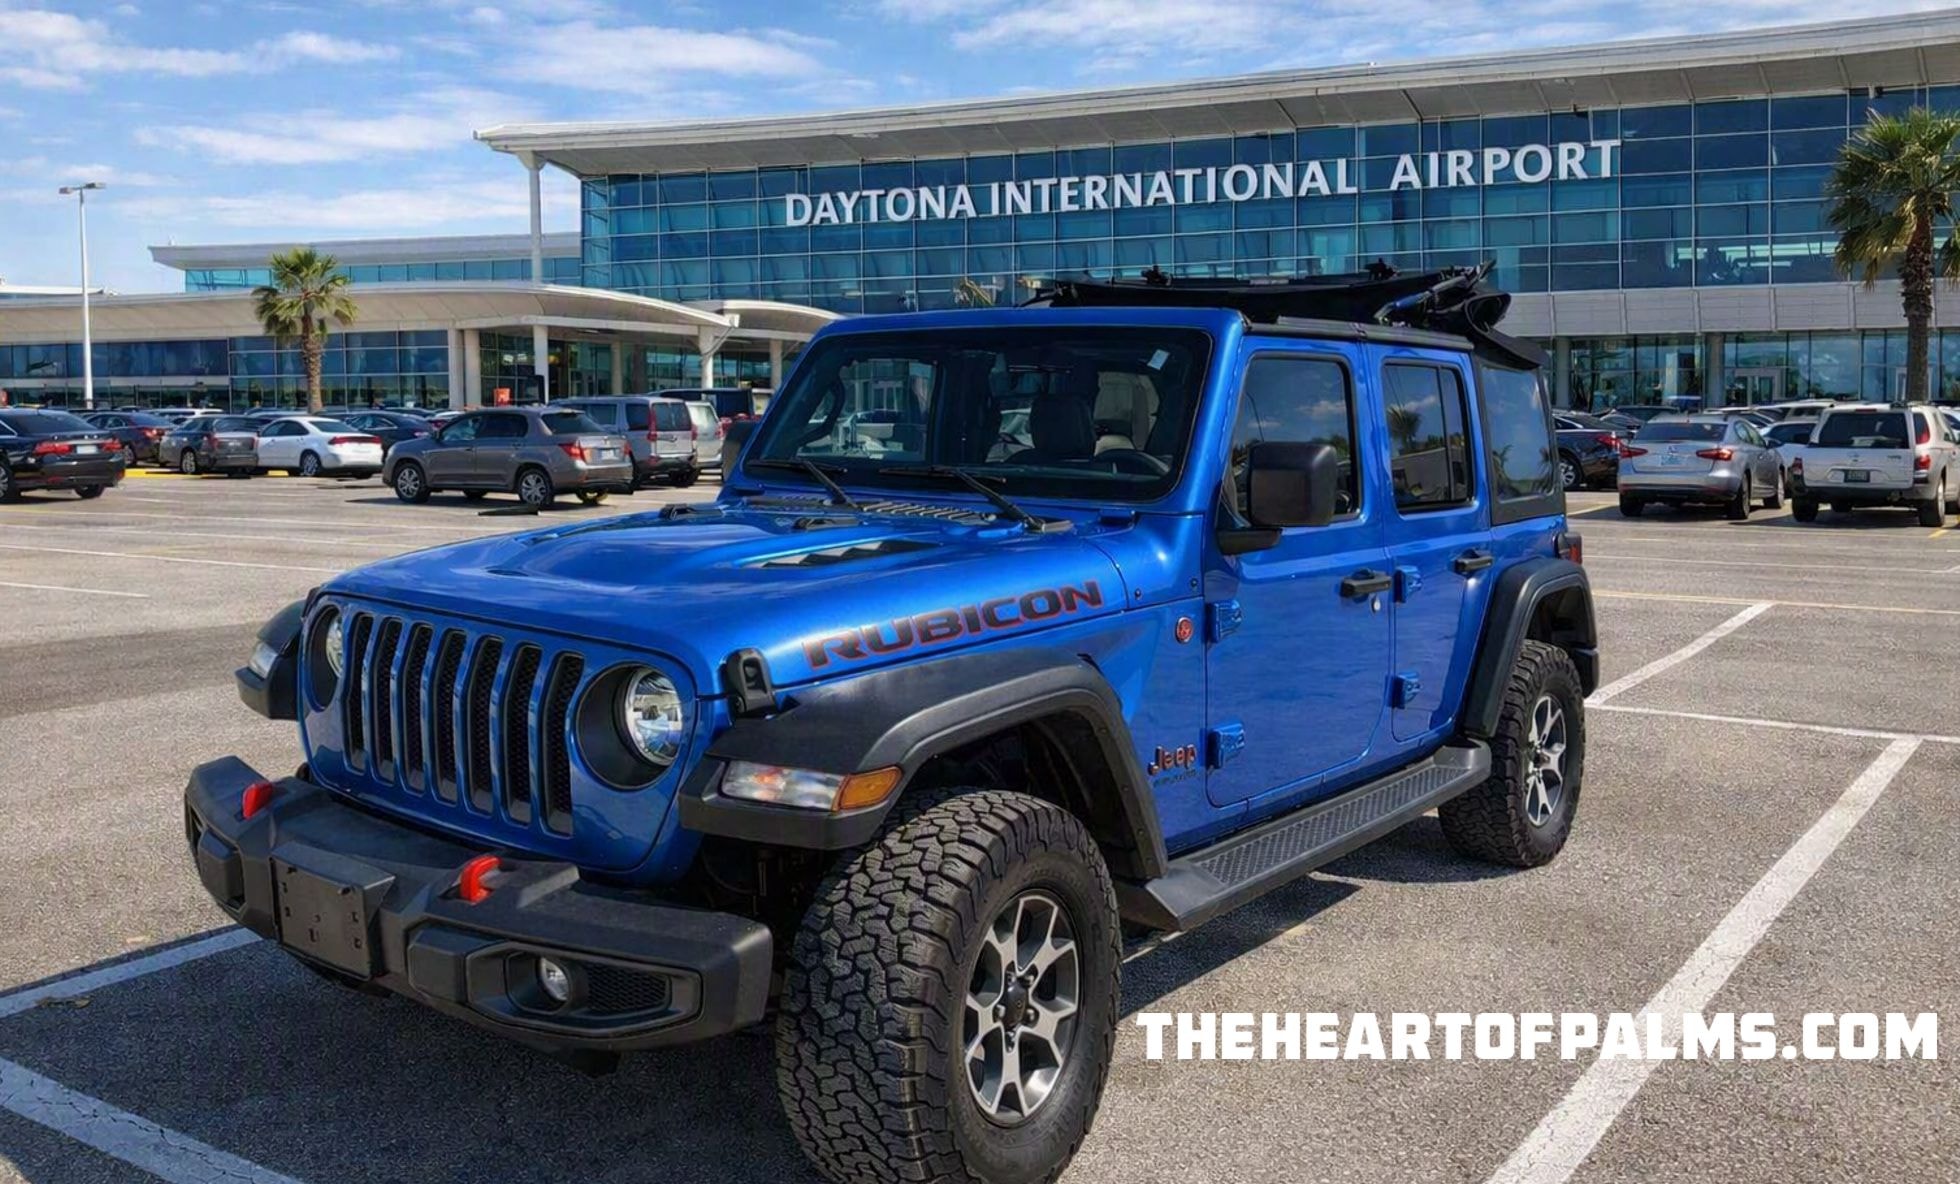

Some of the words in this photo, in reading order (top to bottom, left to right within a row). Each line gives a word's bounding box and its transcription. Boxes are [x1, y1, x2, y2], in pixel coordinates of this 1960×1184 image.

[785, 184, 977, 226] DAYTONA
[991, 158, 1359, 216] INTERNATIONAL
[1390, 139, 1622, 190] AIRPORT
[801, 580, 1105, 669] RUBICON
[1147, 744, 1196, 776] Jeep
